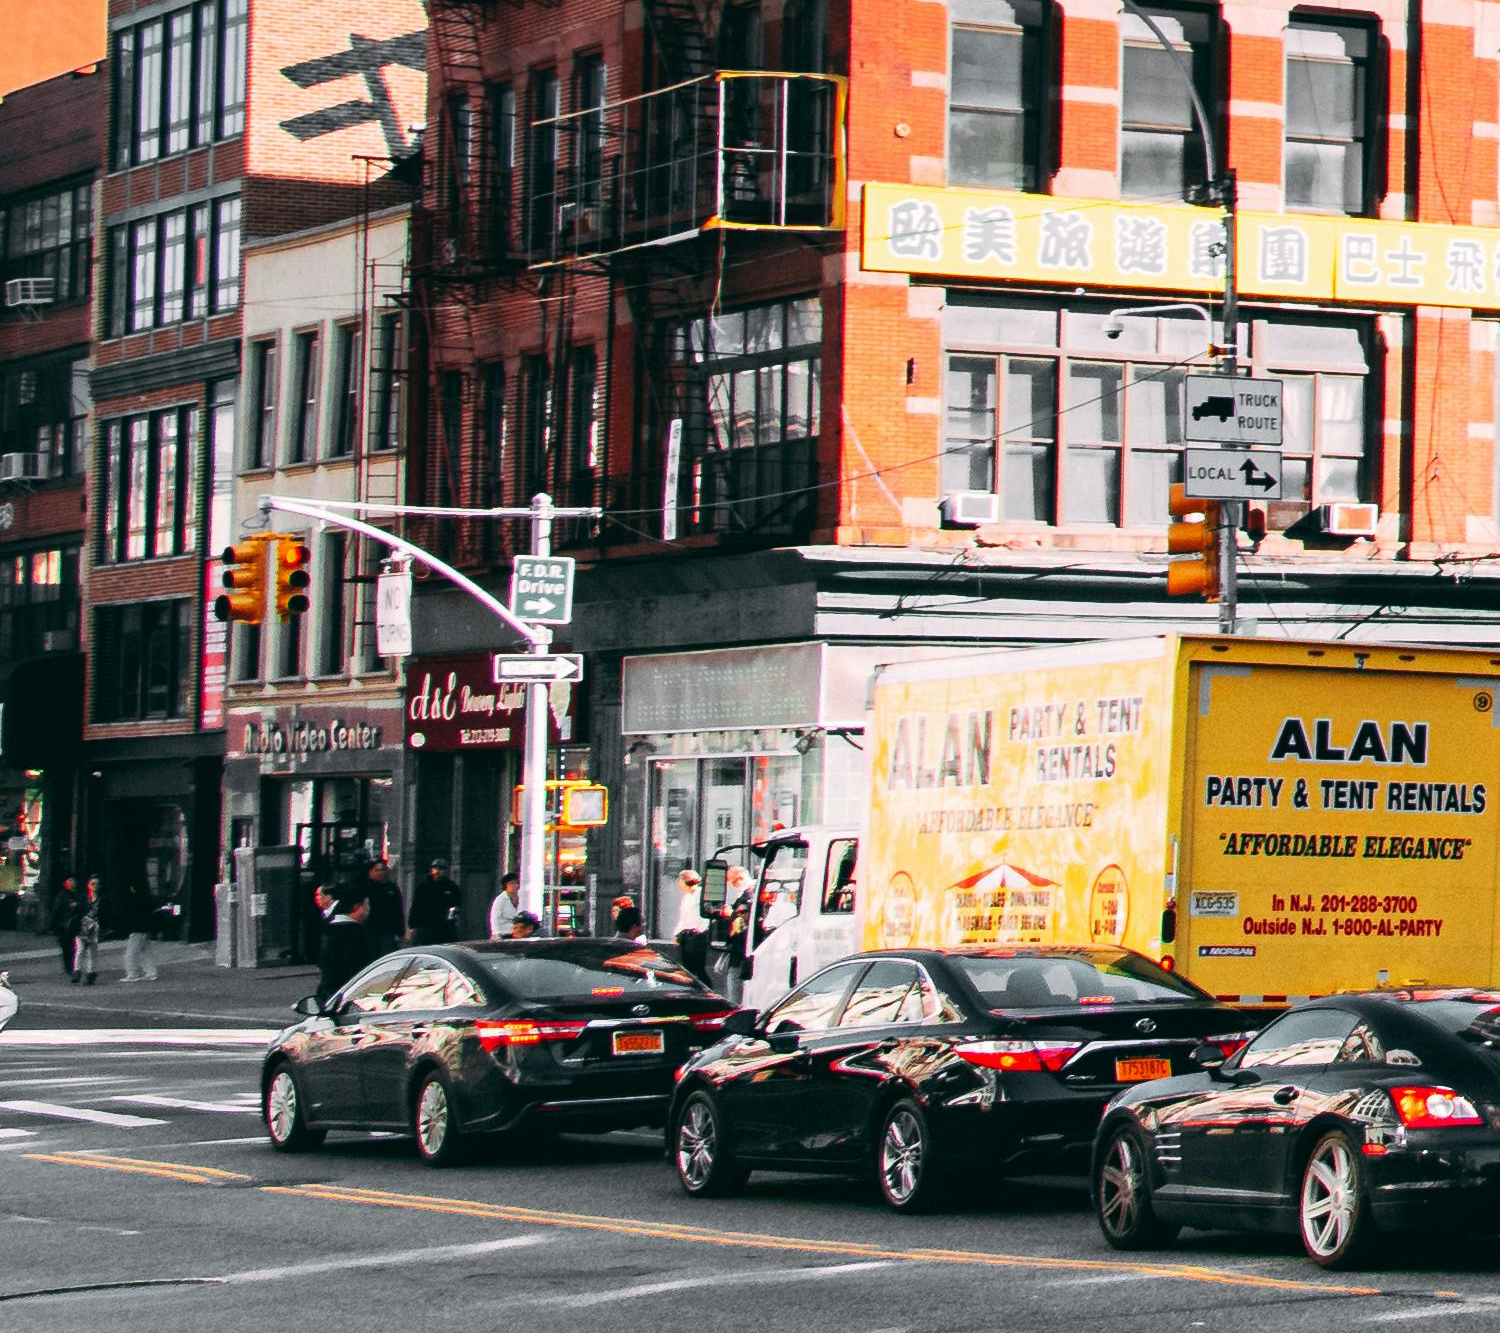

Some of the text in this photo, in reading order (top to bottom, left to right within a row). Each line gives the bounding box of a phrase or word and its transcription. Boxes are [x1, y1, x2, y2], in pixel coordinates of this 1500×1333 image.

[1239, 393, 1278, 408] TRUCK
[1238, 416, 1278, 430] ROUTE
[1188, 466, 1237, 481] LOCAL
[519, 563, 565, 579] F.D.R.
[518, 580, 566, 595] Drive
[1009, 696, 1144, 741] PARTY & TENT
[330, 719, 377, 751] Center
[1268, 716, 1429, 766] ALAN
[888, 709, 993, 791] ALAN
[1036, 742, 1117, 782] RENTALS
[1205, 776, 1487, 815] PARTY & TENT RENTALS
[1272, 893, 1418, 914] In N.J. 201-288-3700
[1243, 916, 1444, 938] Outside N.J. 1-800-AL-PARTY
